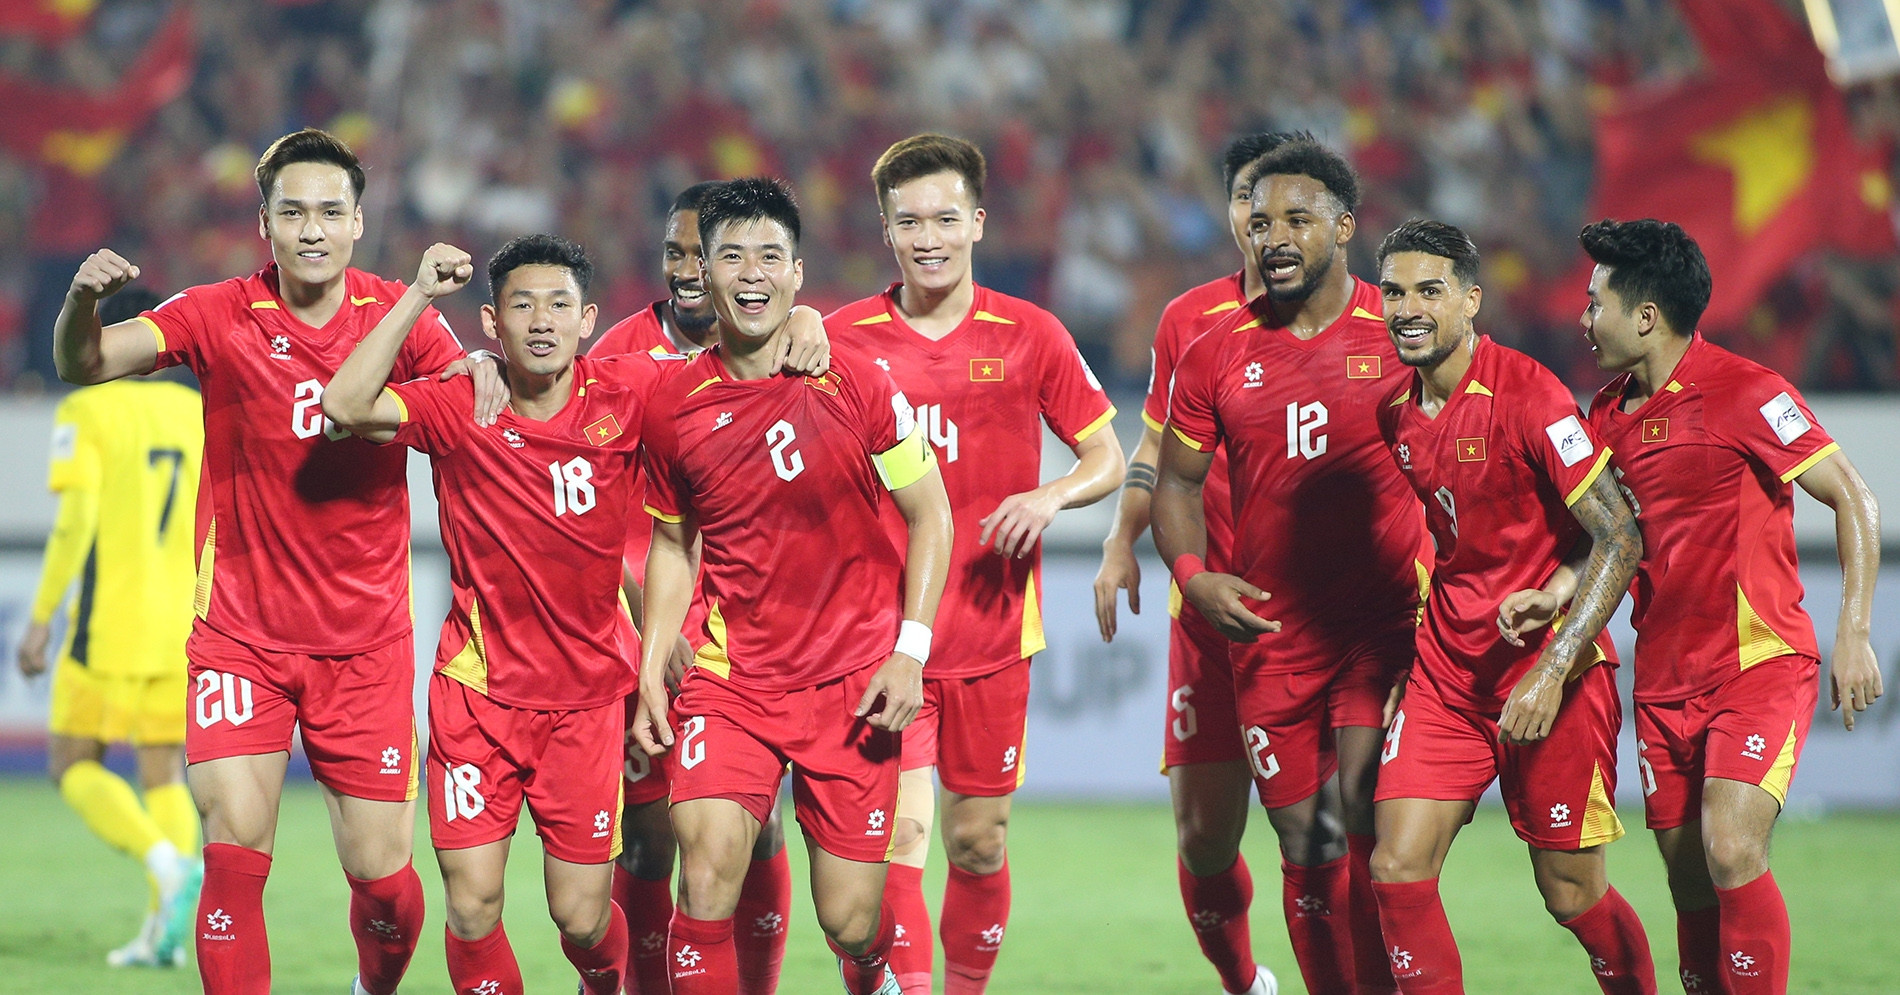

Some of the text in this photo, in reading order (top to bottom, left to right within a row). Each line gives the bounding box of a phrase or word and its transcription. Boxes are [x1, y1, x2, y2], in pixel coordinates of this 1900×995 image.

[916, 403, 959, 464] 14
[1286, 400, 1329, 461] 12
[1560, 428, 1583, 452] AFC
[1776, 406, 1798, 430] AFC
[765, 419, 804, 483] 2
[147, 448, 184, 546] 7
[548, 456, 597, 518] 18
[1429, 485, 1461, 541] 9
[195, 669, 255, 730] 20
[1171, 684, 1199, 742] 5
[681, 716, 706, 771] 2
[1379, 709, 1405, 766] 9
[444, 762, 486, 823] 18
